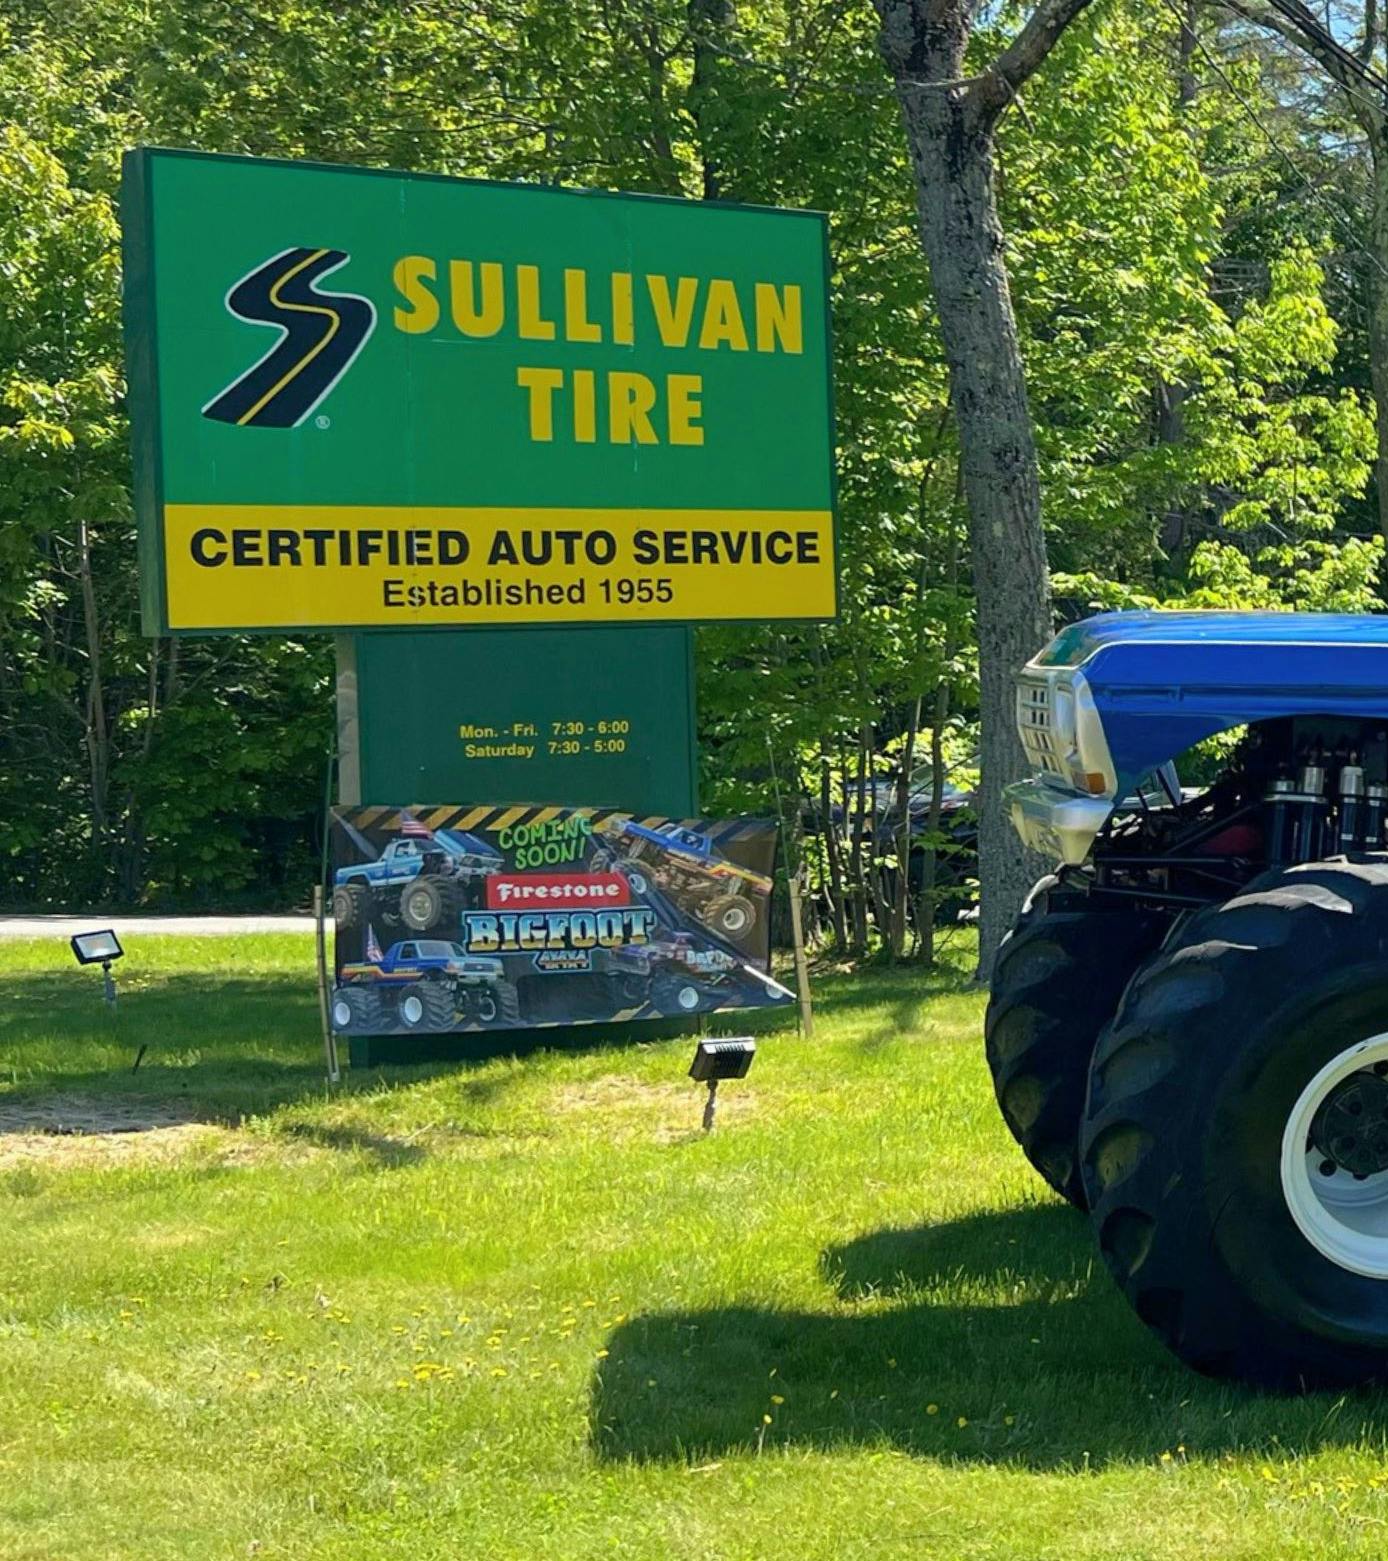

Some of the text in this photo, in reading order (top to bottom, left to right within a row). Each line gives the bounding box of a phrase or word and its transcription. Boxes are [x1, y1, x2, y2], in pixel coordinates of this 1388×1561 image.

[393, 255, 803, 354] SULLIVAN
[517, 367, 704, 446] TIRE
[190, 528, 820, 567] CERTIFIED AUTO SERVICE
[384, 578, 674, 608] Established 1955
[460, 725, 498, 738] Mon.
[513, 724, 538, 737] Fri.
[552, 722, 584, 735] 7:30
[598, 721, 629, 734] 6:00
[465, 743, 534, 758] Saturday
[548, 741, 580, 754] 7:30
[594, 740, 625, 753] 5:00
[515, 837, 585, 870] SOON!
[497, 883, 620, 902] Firestone
[467, 911, 653, 951] BIGFOOT
